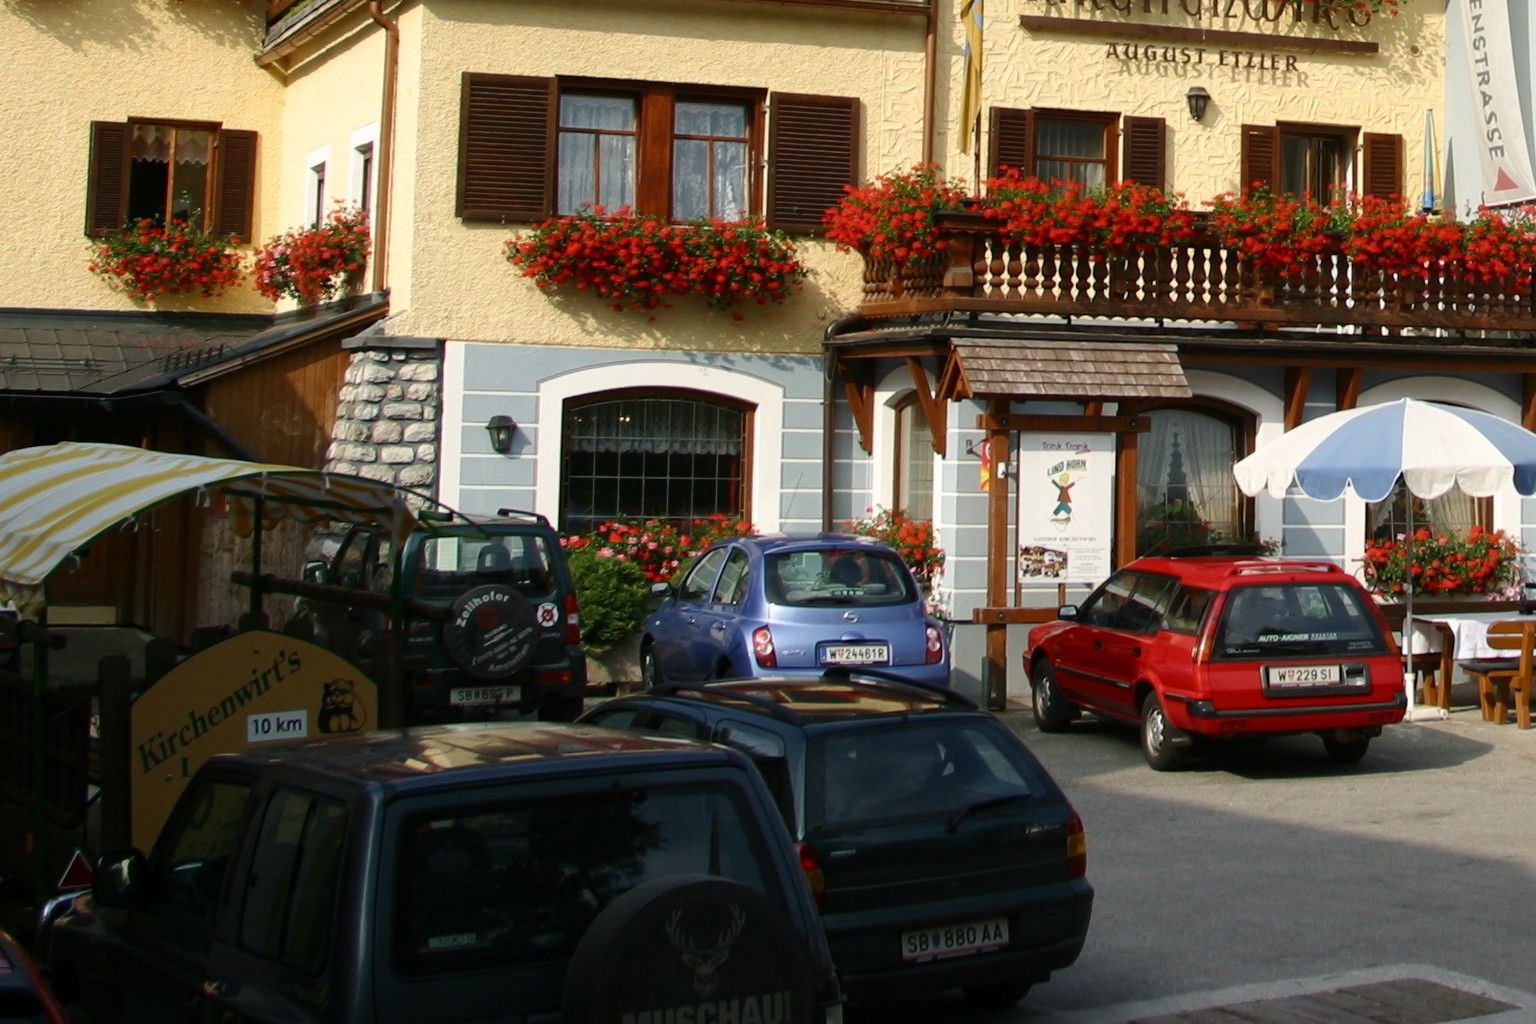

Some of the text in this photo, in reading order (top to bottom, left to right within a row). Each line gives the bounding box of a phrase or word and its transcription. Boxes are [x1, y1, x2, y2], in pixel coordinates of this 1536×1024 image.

[1105, 41, 1299, 72] AUGUST ETZLER
[829, 649, 837, 660] W
[1278, 668, 1332, 682] W 229 SI
[136, 649, 302, 774] Kirchenwirt's
[253, 717, 303, 735] 10 km
[907, 922, 1003, 953] SB 880 AA
